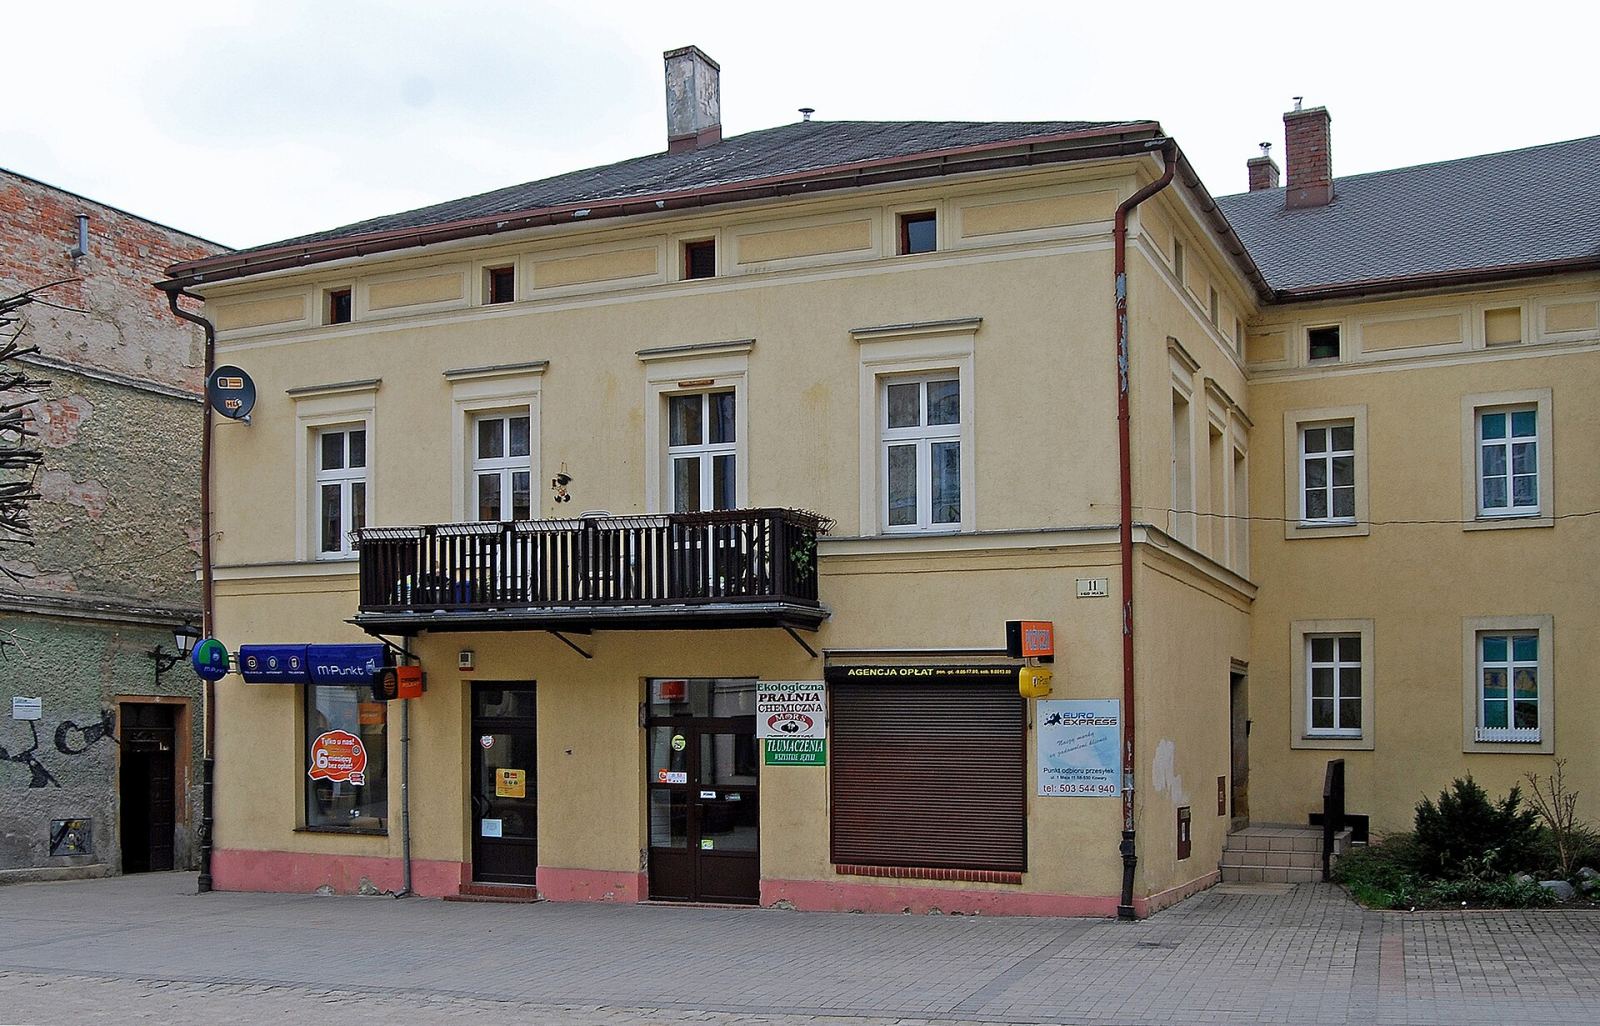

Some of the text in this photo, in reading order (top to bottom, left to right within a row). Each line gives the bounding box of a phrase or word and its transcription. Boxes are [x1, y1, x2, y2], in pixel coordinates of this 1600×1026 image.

[1088, 580, 1097, 591] 11
[848, 668, 897, 676] AGENCJA
[899, 668, 934, 676] OPŁAT
[757, 682, 825, 693] Ekologiczna
[758, 693, 821, 702] PRALNIA
[758, 703, 823, 713] CHEMICZNA
[775, 713, 808, 723] MORS
[321, 737, 336, 747] Tylko
[767, 739, 824, 752] TŁUMACZENIA
[316, 748, 329, 769] 6
[1085, 767, 1115, 776] przesyłek
[1043, 784, 1115, 793] tel: 503 544 940
